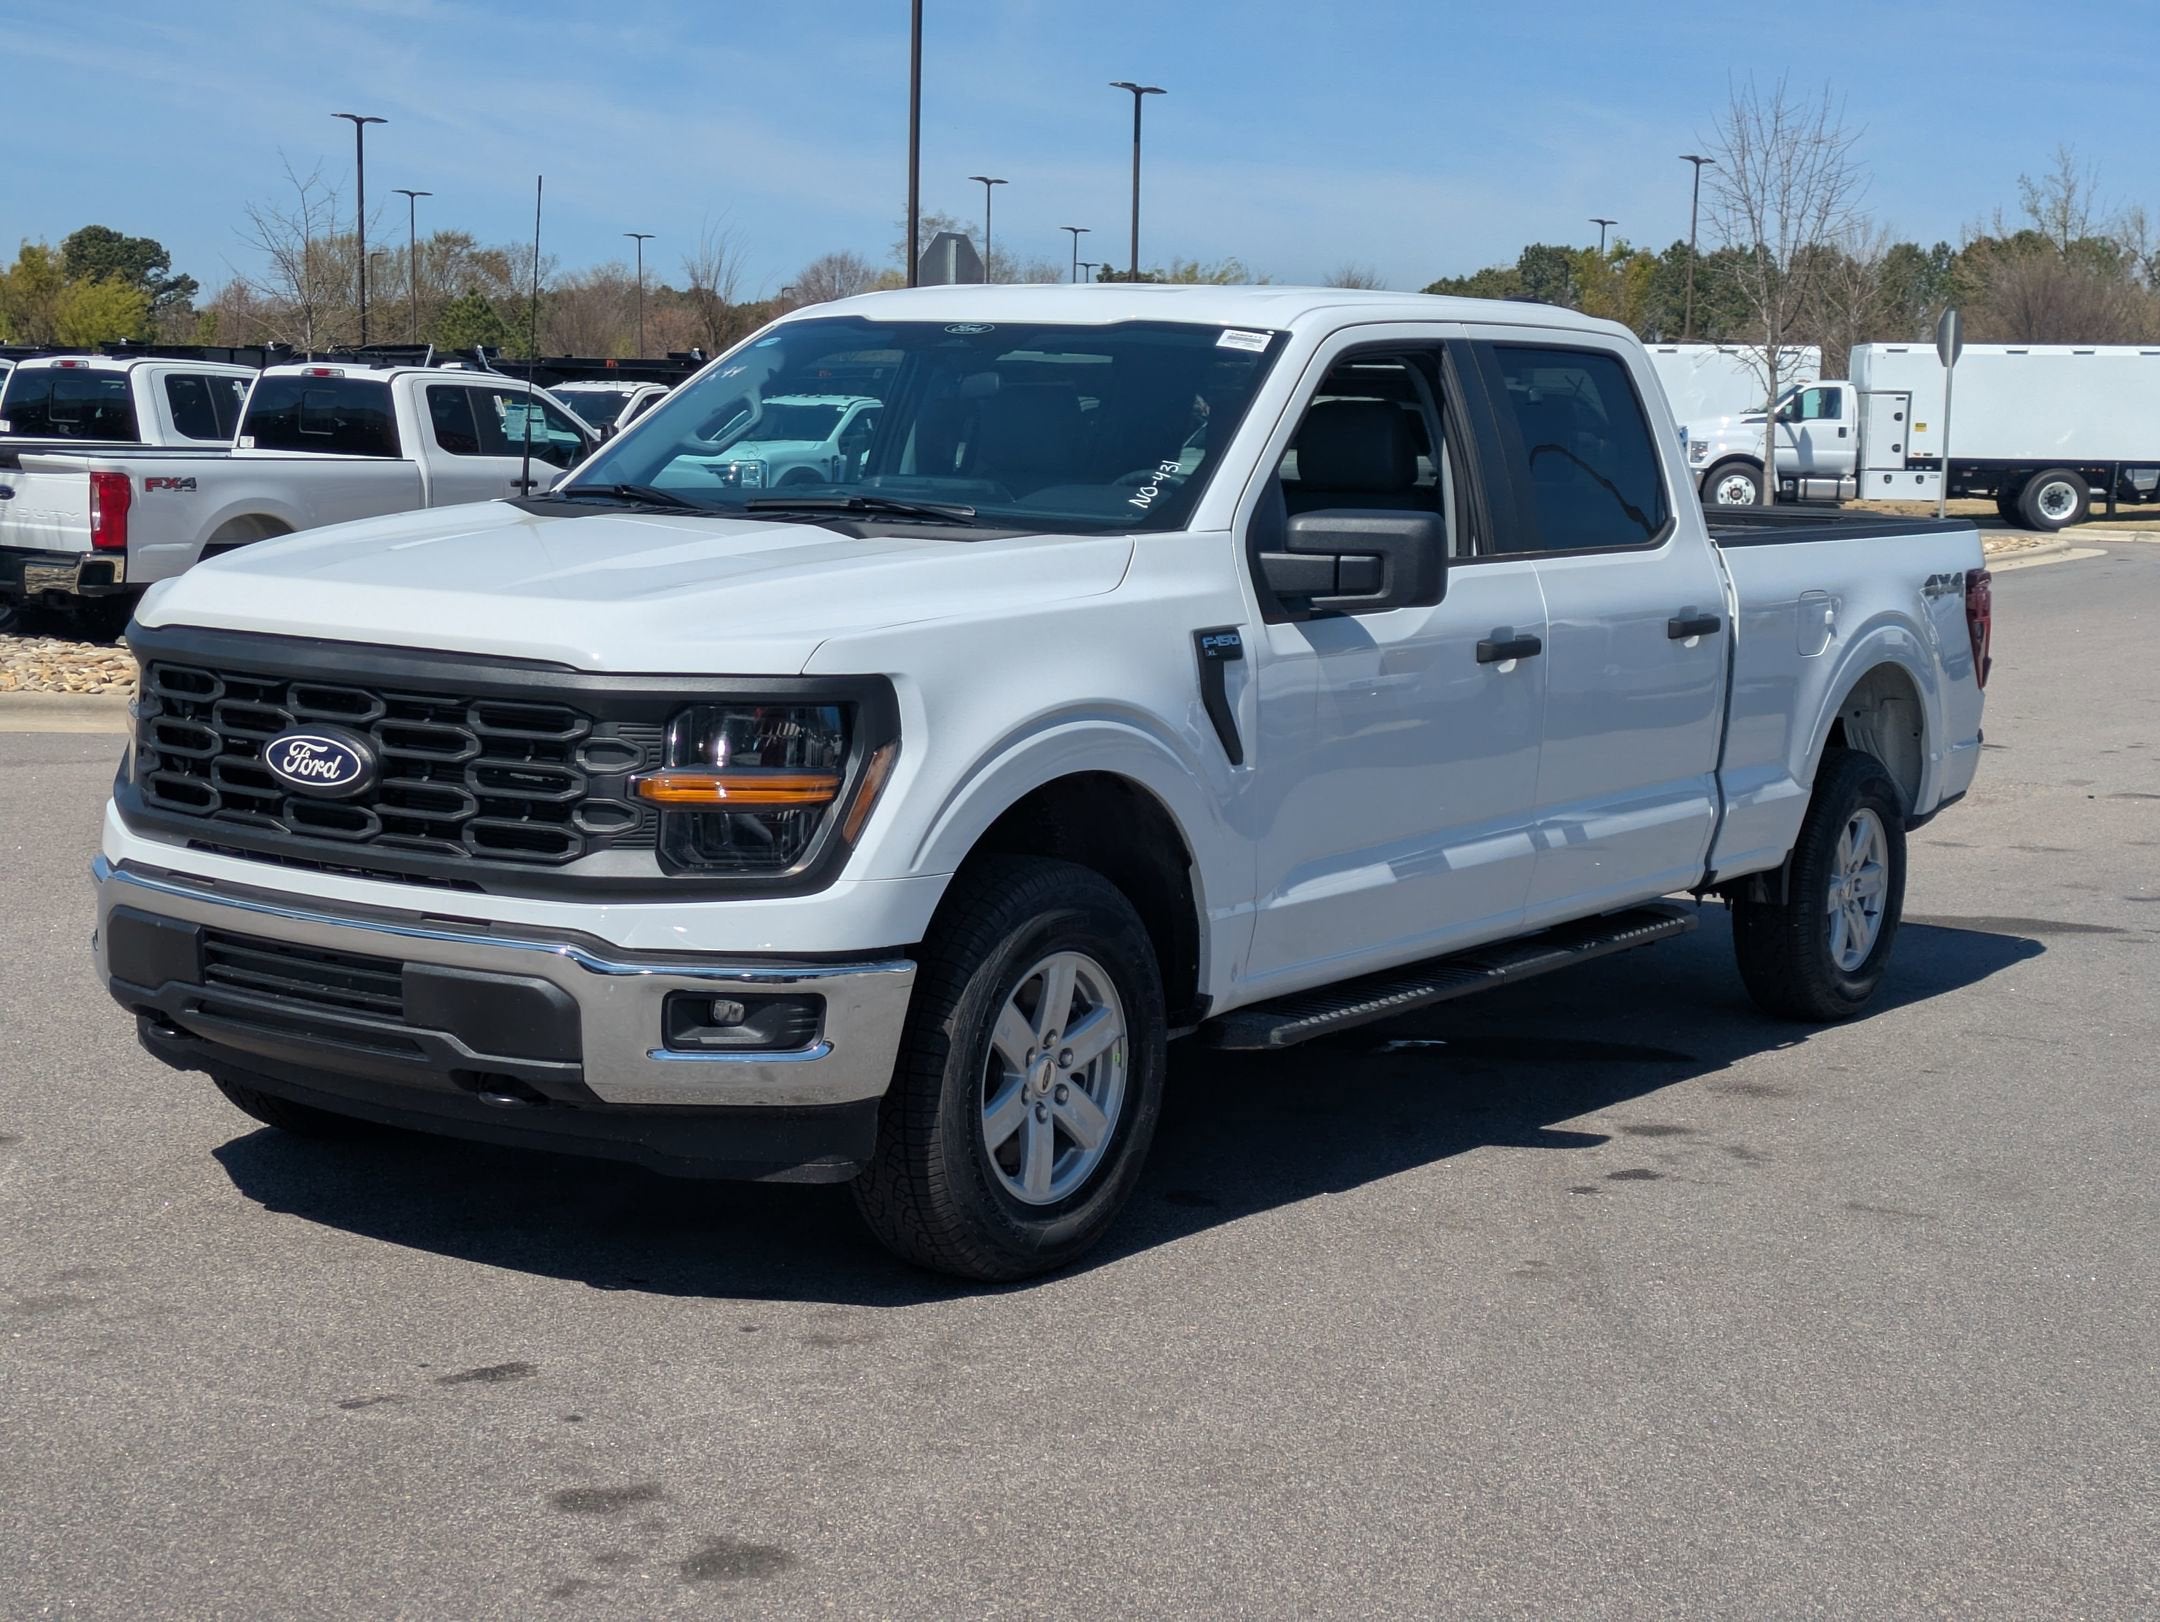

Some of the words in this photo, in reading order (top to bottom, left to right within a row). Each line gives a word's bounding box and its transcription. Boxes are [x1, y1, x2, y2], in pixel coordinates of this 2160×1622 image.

[145, 476, 197, 492] FX4
[1128, 460, 1182, 509] NO-431
[283, 741, 342, 779] Ford
